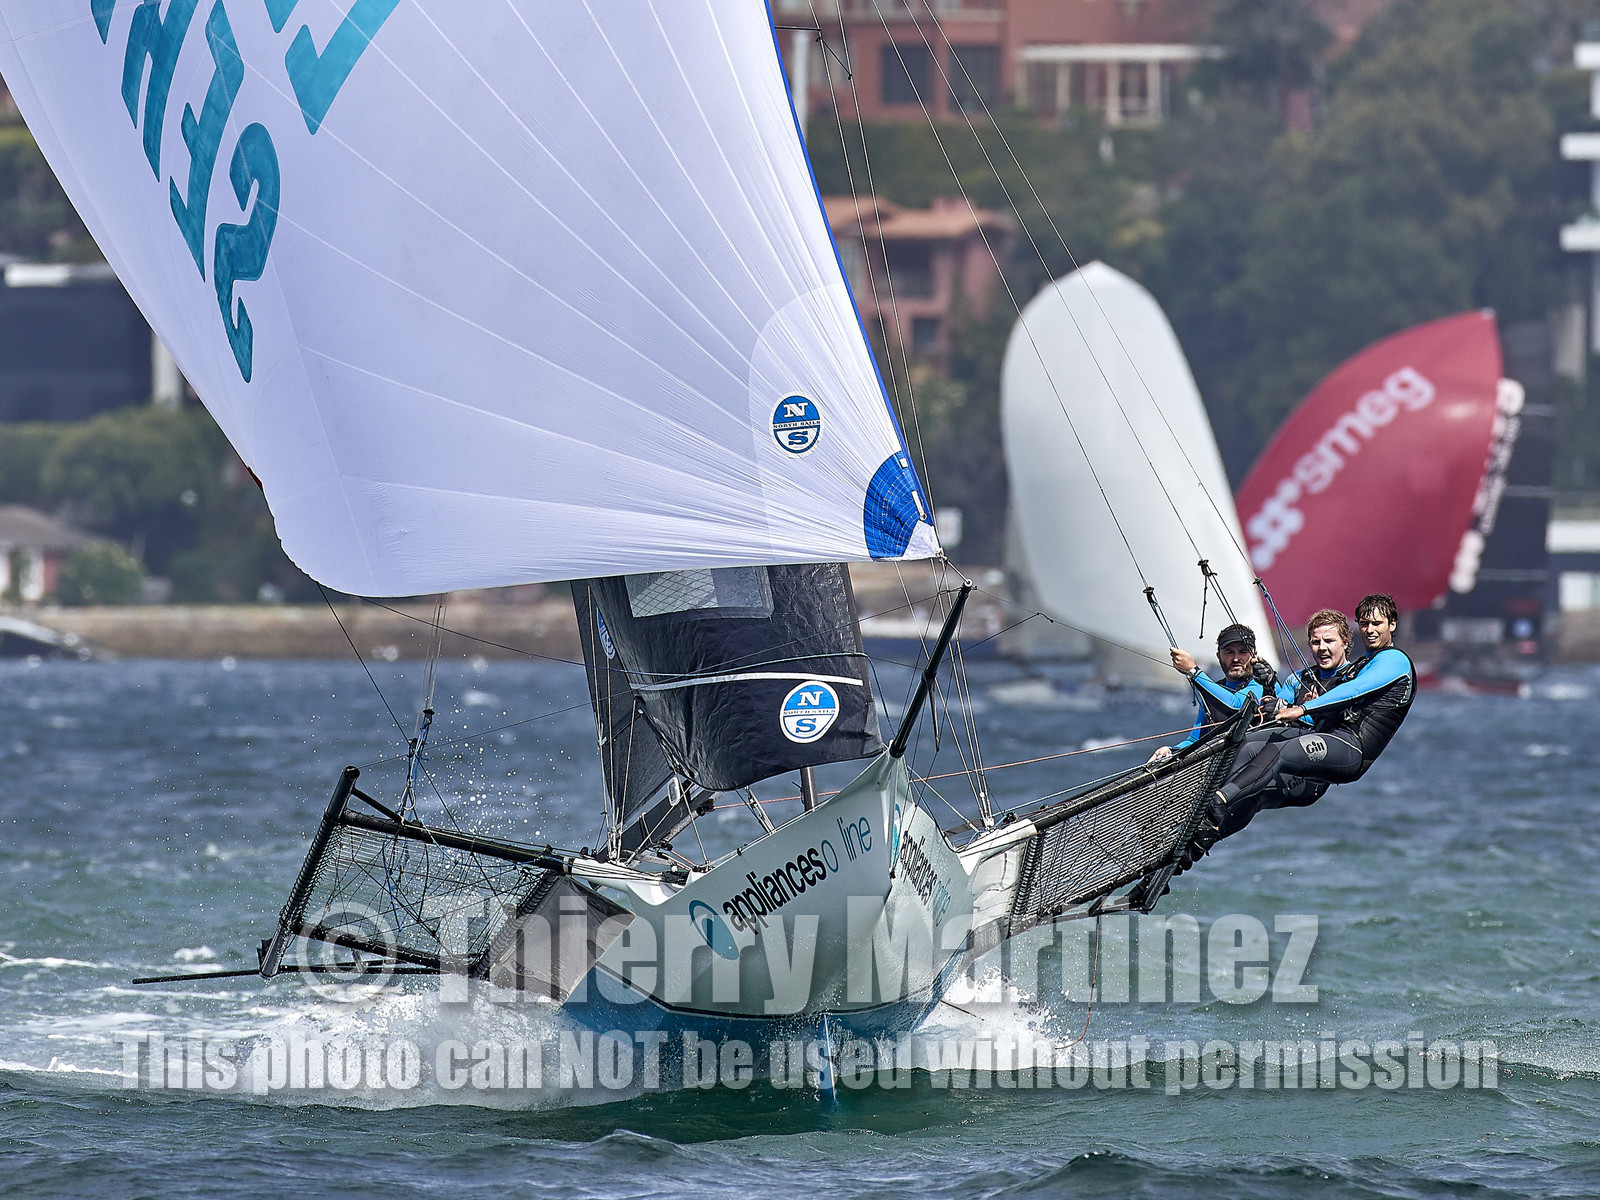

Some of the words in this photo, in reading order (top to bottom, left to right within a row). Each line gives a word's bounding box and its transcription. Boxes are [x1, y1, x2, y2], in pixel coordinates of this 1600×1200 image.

[783, 402, 808, 418] N
[788, 430, 809, 446] S
[1292, 366, 1436, 494] smeg
[797, 690, 824, 707] N
[795, 717, 817, 734] S
[1305, 740, 1325, 755] Gill
